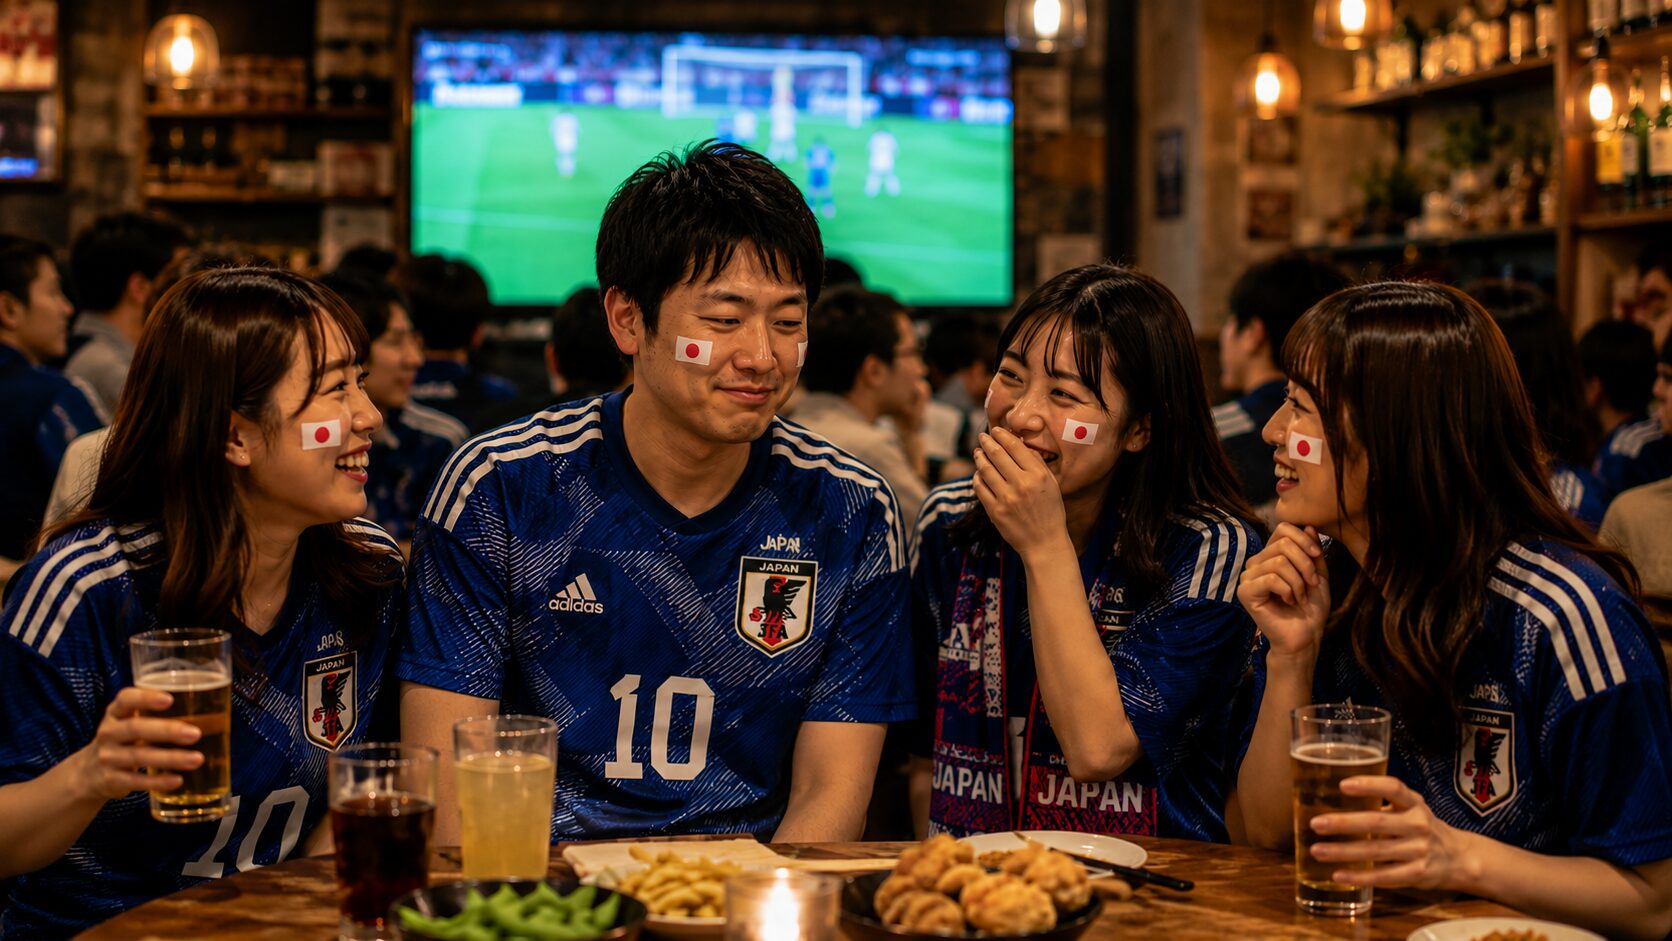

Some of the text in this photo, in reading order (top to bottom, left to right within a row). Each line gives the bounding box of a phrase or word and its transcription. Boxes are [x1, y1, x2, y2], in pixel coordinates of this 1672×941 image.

[759, 562, 800, 574] JAPAN
[548, 598, 604, 614] adidas
[316, 659, 346, 672] JAPAN
[605, 673, 716, 780] 10
[932, 762, 1003, 804] JAPAN
[1037, 774, 1143, 813] JAPAN
[181, 785, 311, 879] 10
